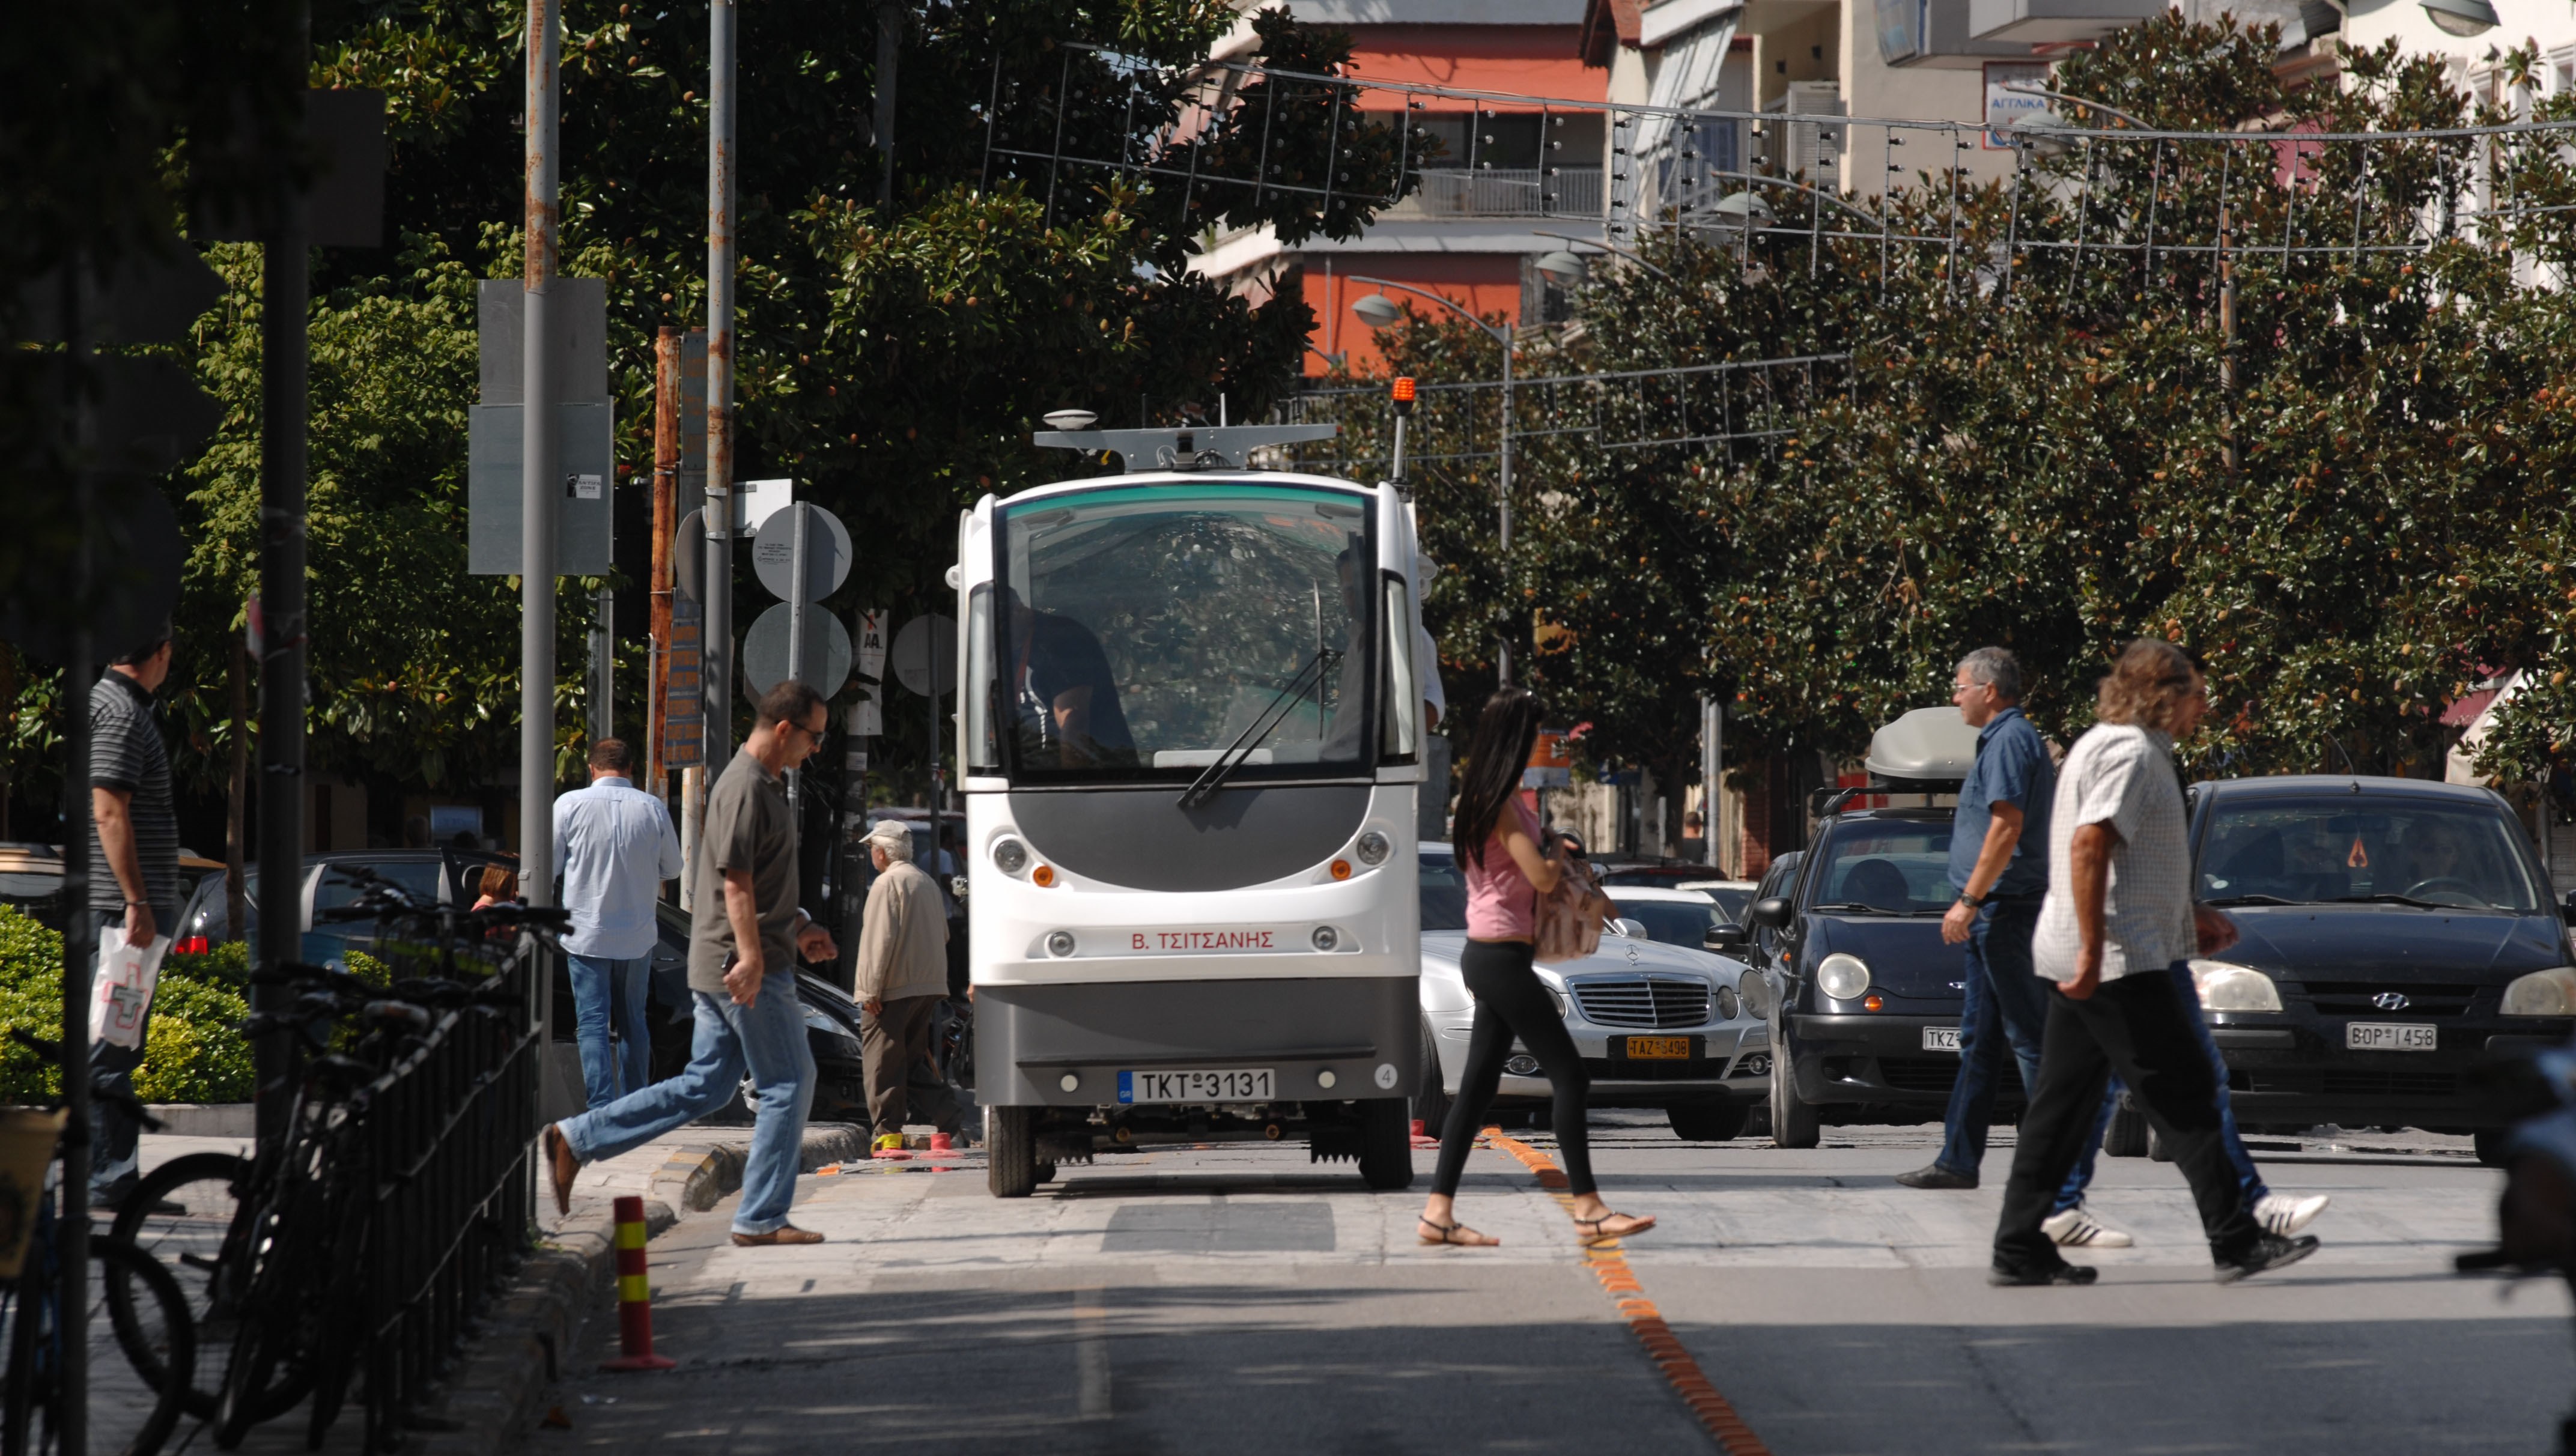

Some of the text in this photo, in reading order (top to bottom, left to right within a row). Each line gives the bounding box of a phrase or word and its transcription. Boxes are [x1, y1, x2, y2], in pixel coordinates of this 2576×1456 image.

[1992, 98, 2046, 109] ΑΓΓΛΙΚΑ
[1132, 932, 1274, 950] Β. ΤΣΙΤΣΑΝΗΣ
[1382, 1070, 1390, 1083] 4
